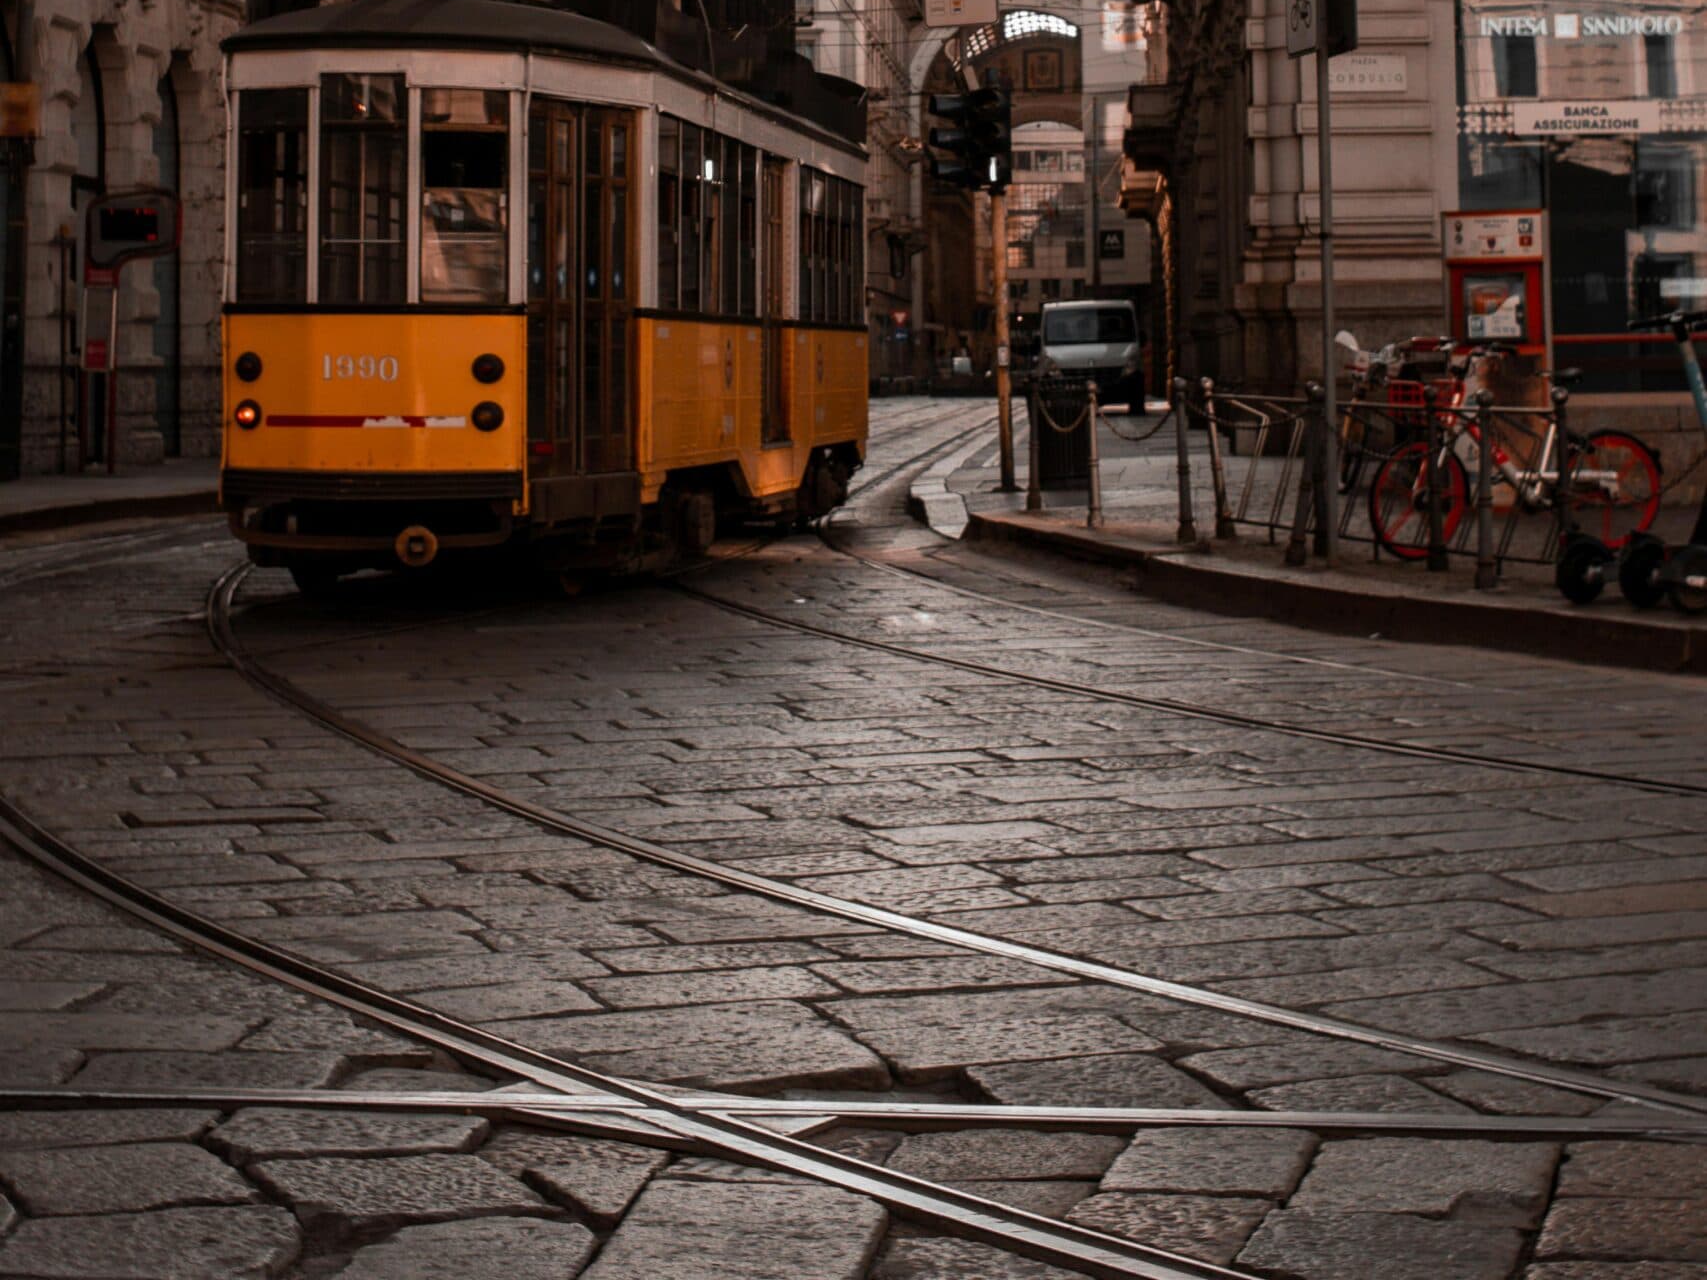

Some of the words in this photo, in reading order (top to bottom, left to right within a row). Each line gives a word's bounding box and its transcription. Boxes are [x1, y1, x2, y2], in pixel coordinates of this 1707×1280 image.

[1480, 15, 1548, 36] INTESA
[1563, 106, 1608, 117] BANCA
[1533, 119, 1639, 130] ASSICURAZIONE
[323, 353, 399, 382] 1990
